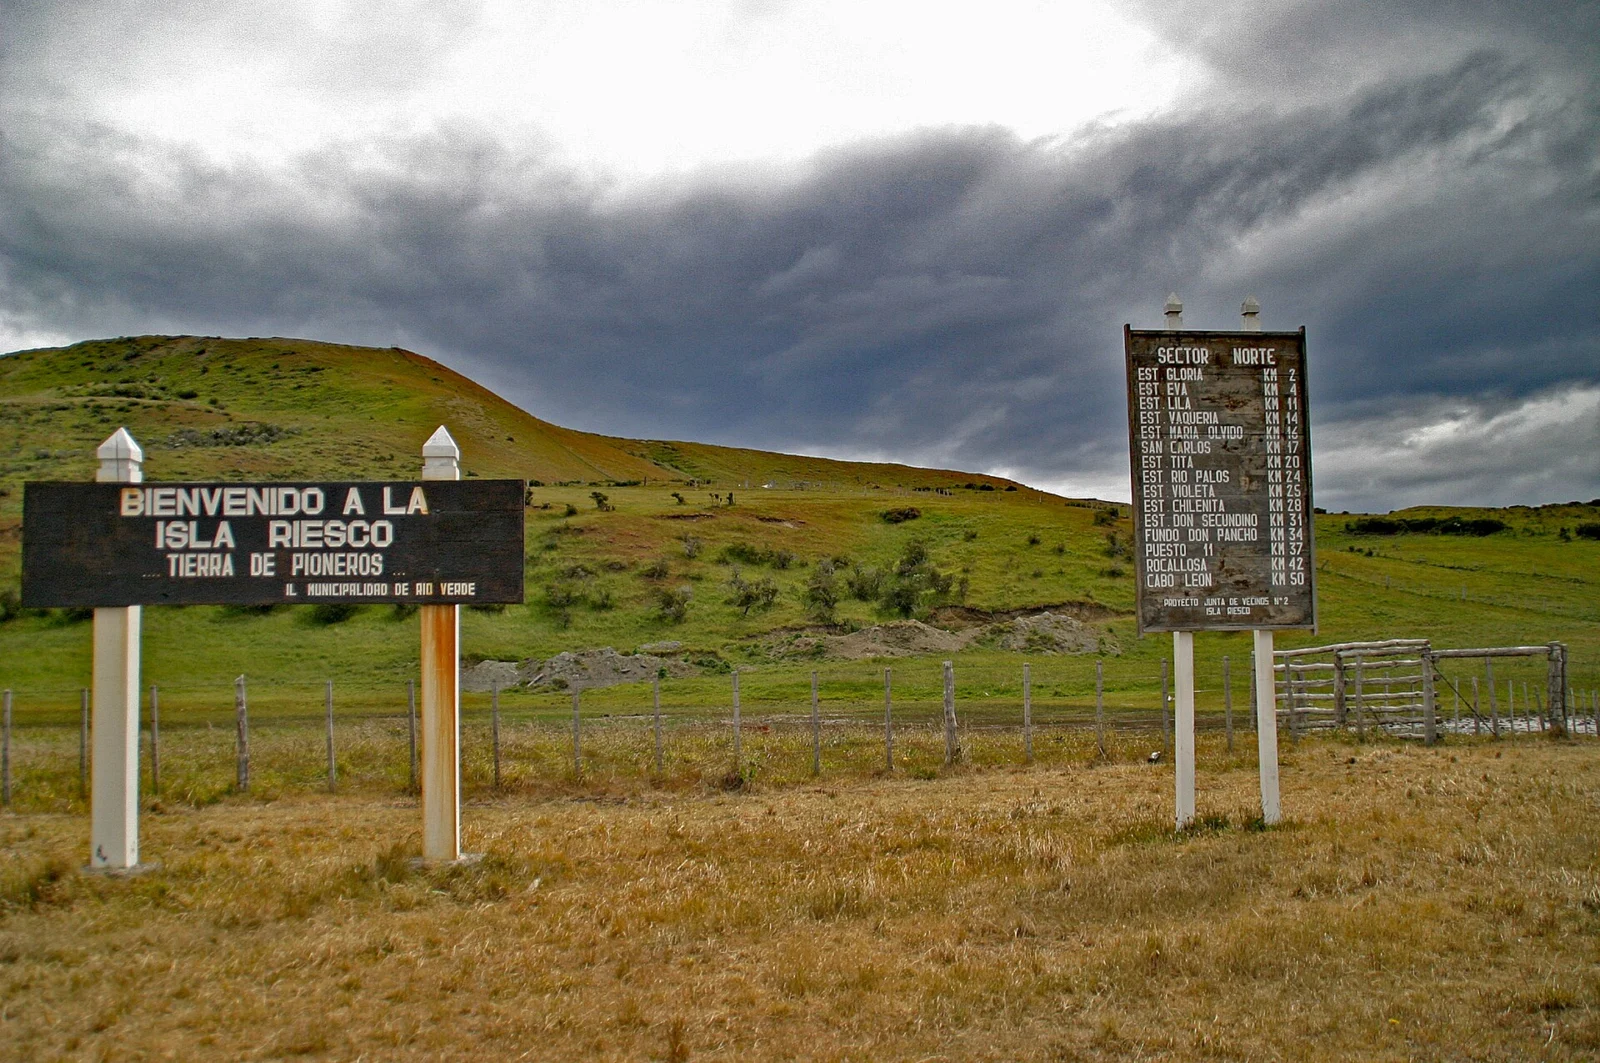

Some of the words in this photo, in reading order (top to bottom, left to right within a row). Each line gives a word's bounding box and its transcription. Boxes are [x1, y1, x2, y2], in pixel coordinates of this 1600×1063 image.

[1157, 347, 1209, 364] SECTOR
[1233, 348, 1276, 365] NORTE
[1166, 368, 1203, 381] GLORIA
[1263, 368, 1277, 381] KM
[1289, 368, 1296, 382] 2
[1167, 383, 1187, 396] EVA
[1264, 383, 1278, 396] KM
[1289, 384, 1297, 396] 4
[1167, 397, 1191, 410] LILA
[1265, 397, 1279, 410] KM
[1287, 398, 1298, 410] 11
[1169, 412, 1219, 425] VAQUERIA
[1265, 412, 1280, 425] KM
[1286, 412, 1298, 425] 14
[1170, 426, 1199, 440] MARIA
[1208, 426, 1243, 440] OLVIDO
[1266, 426, 1280, 440] KM
[1287, 426, 1298, 440] 16
[1141, 441, 1163, 454] SAN
[1171, 441, 1211, 454] CARLOS
[1267, 441, 1281, 454] KM
[1287, 441, 1299, 454] 17
[1171, 455, 1194, 469] TITA
[1267, 456, 1281, 469] KM
[1285, 456, 1300, 469] 20
[1171, 470, 1188, 483] RIO
[1196, 470, 1230, 483] PALOS
[1267, 470, 1282, 483] KM
[1286, 470, 1301, 483] 24
[1173, 485, 1216, 498] VIOLETA
[1268, 484, 1283, 498] KM
[1286, 484, 1301, 498] 25
[120, 487, 324, 516] BIENVENIDO
[343, 487, 365, 515] A
[383, 486, 429, 515] LA
[1173, 499, 1226, 512] CHILENITA
[1269, 499, 1283, 512] KM
[1287, 498, 1302, 512] 28
[1173, 514, 1194, 527] DON
[1202, 514, 1258, 527] SECUNDINO
[1270, 514, 1284, 526] KM
[1289, 514, 1302, 526] 31
[156, 521, 235, 548] ISLA
[269, 520, 393, 548] RIESCO
[1145, 529, 1180, 542] FUNDO
[1188, 528, 1209, 542] DON
[1217, 528, 1258, 541] PANCHO
[1270, 528, 1285, 541] KM
[1289, 528, 1303, 541] 34
[1146, 544, 1187, 557] PUESTO
[1203, 543, 1213, 556] 11
[1271, 542, 1285, 556] KM
[1289, 542, 1303, 556] 37
[167, 553, 234, 577] TIERRA
[251, 553, 275, 576] DE
[291, 553, 383, 576] PIONEROS
[1146, 558, 1207, 572] ROCALLOSA
[1272, 558, 1286, 570] KM
[1289, 558, 1304, 570] 42
[1147, 574, 1174, 588] CABO
[1185, 573, 1212, 586] LEON
[1272, 572, 1286, 586] KM
[1290, 572, 1304, 585] 50
[286, 583, 297, 596] IL
[307, 583, 388, 596] MUNICIPALIDAD
[394, 583, 409, 595] DE
[415, 583, 433, 596] RIO
[440, 582, 476, 596] VERDE
[1164, 599, 1199, 607] PROYECTO
[1204, 598, 1225, 606] JUNTA
[1230, 598, 1238, 606] DE
[1242, 597, 1270, 606] VECINOS
[1206, 607, 1221, 616] ISLA
[1227, 607, 1250, 615] RIESCO
